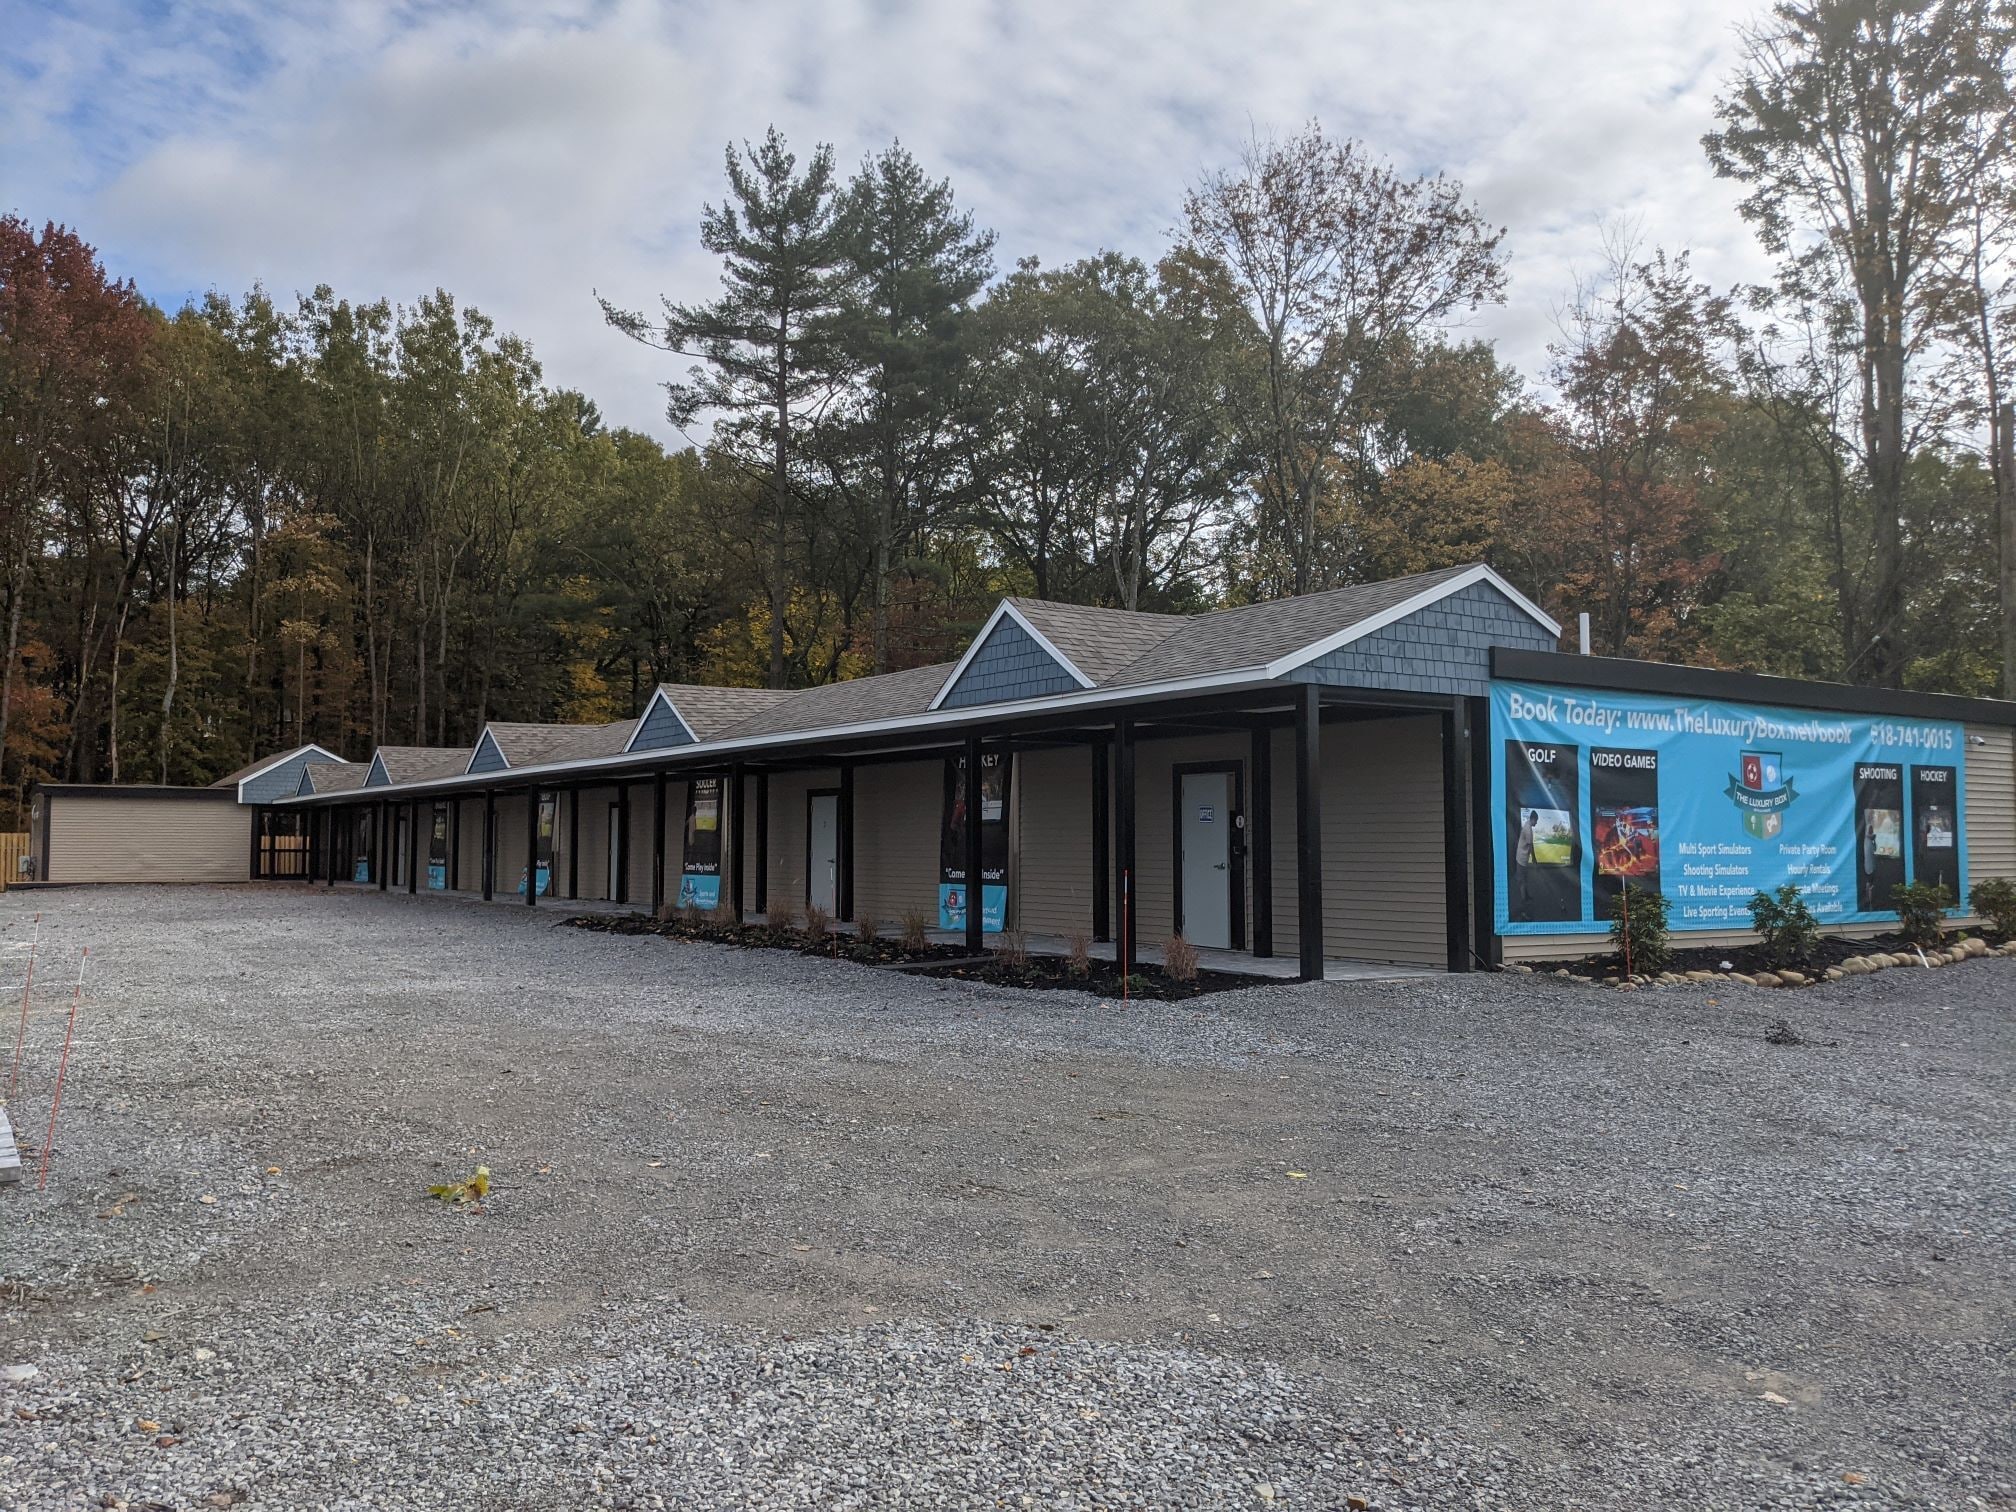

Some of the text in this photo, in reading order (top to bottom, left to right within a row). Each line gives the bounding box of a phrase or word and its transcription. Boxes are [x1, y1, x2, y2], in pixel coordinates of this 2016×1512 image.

[1510, 693, 1558, 723] Book
[1564, 698, 1622, 735] Today:
[959, 754, 999, 769] HKEY
[1528, 748, 1556, 763] GOLF
[1592, 752, 1656, 769] VIDEO GAMES
[1860, 767, 1897, 780] SHOOTING
[1920, 770, 1947, 782] HOCKEY
[1736, 792, 1748, 804] THE
[1749, 797, 1773, 808] LUXURY
[1679, 842, 1752, 858] Multi Sport Simulators
[1779, 844, 1800, 855] Private
[1802, 844, 1820, 857] Party
[1683, 864, 1749, 878] Shooting Simulators
[1678, 885, 1755, 899] TV & Movie Experience
[1683, 906, 1697, 917] Live
[1699, 905, 1728, 920] Sporting
